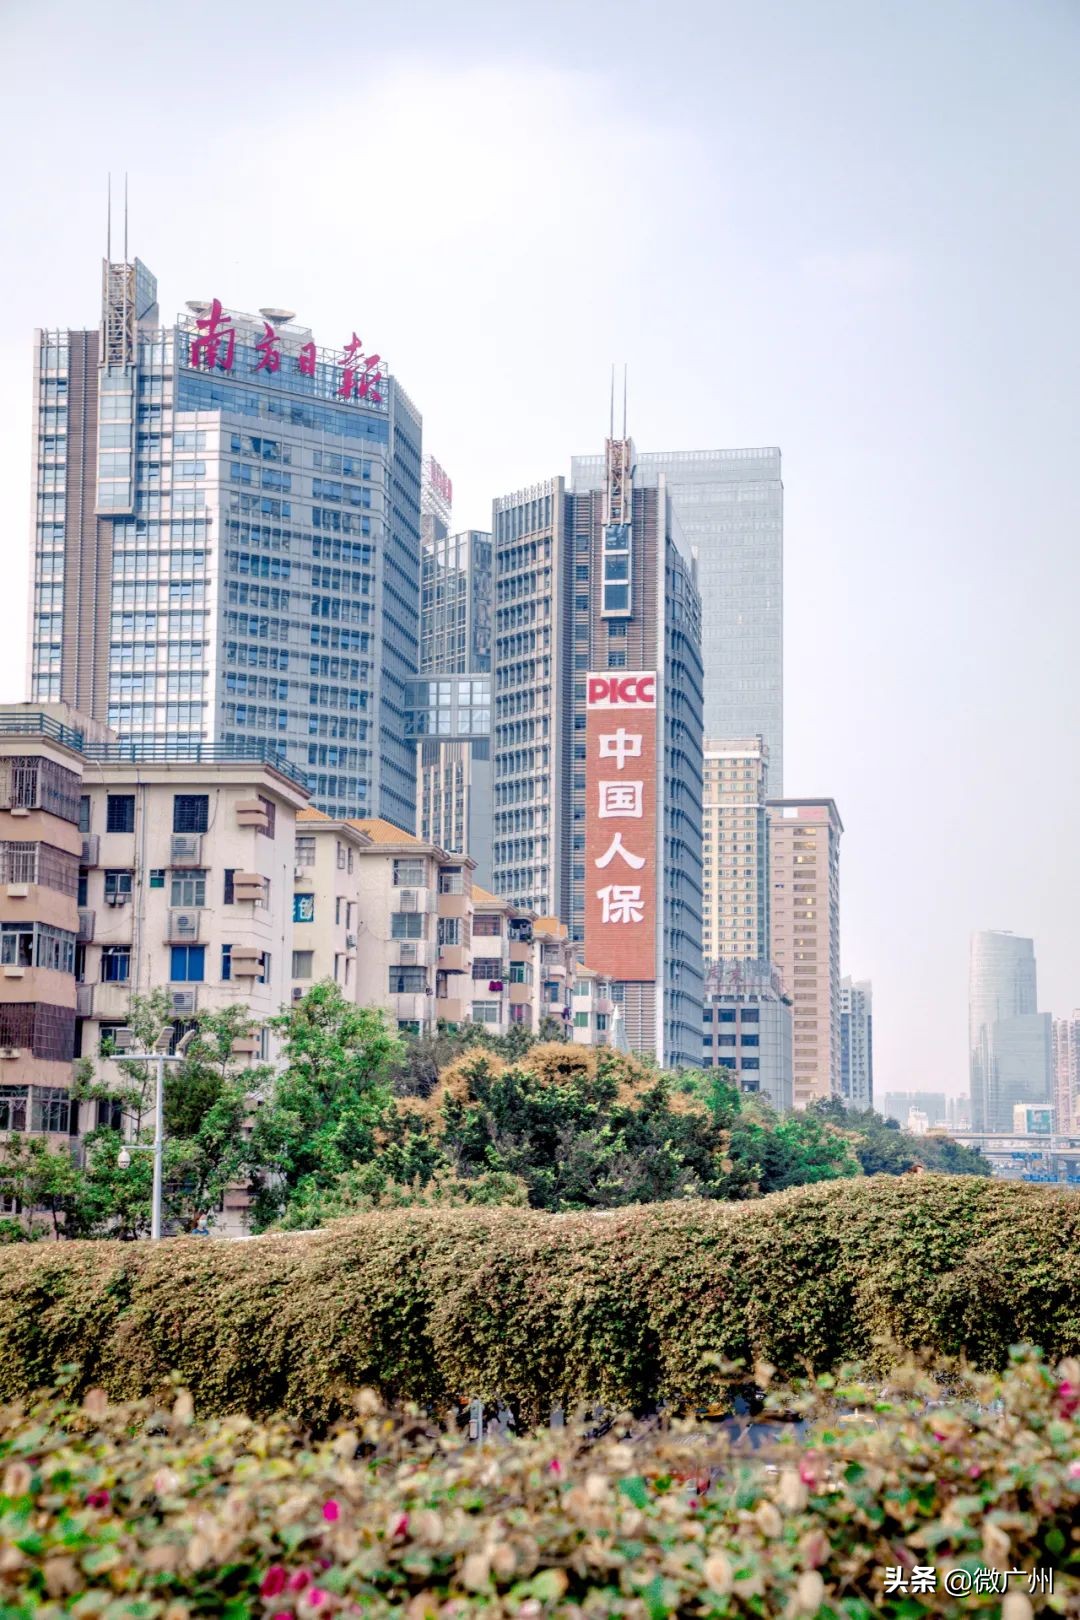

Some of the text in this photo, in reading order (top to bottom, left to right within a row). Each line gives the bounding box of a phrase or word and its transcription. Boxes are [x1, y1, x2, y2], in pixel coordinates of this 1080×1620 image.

[588, 677, 655, 705] PICC
[594, 727, 646, 924] 中国人保
